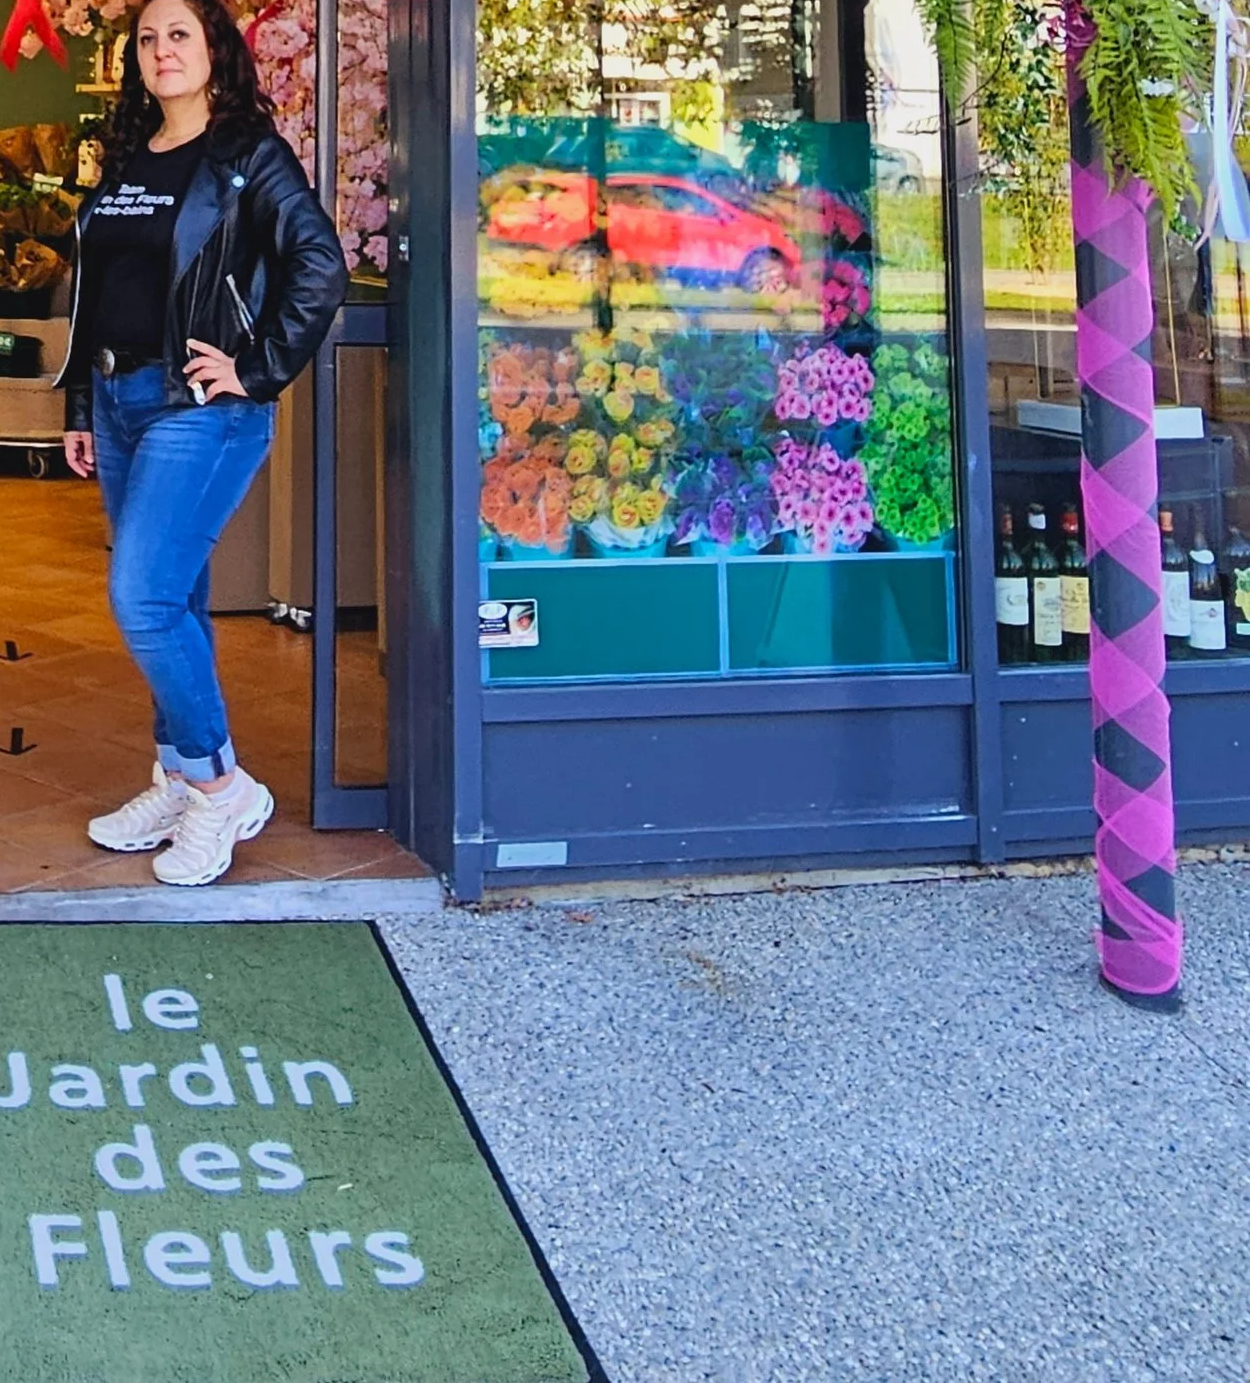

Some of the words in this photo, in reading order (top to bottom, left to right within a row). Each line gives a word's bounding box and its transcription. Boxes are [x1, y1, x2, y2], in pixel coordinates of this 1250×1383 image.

[103, 973, 200, 1032] le
[94, 1124, 305, 1193] des
[27, 1210, 426, 1289] Fleurs
